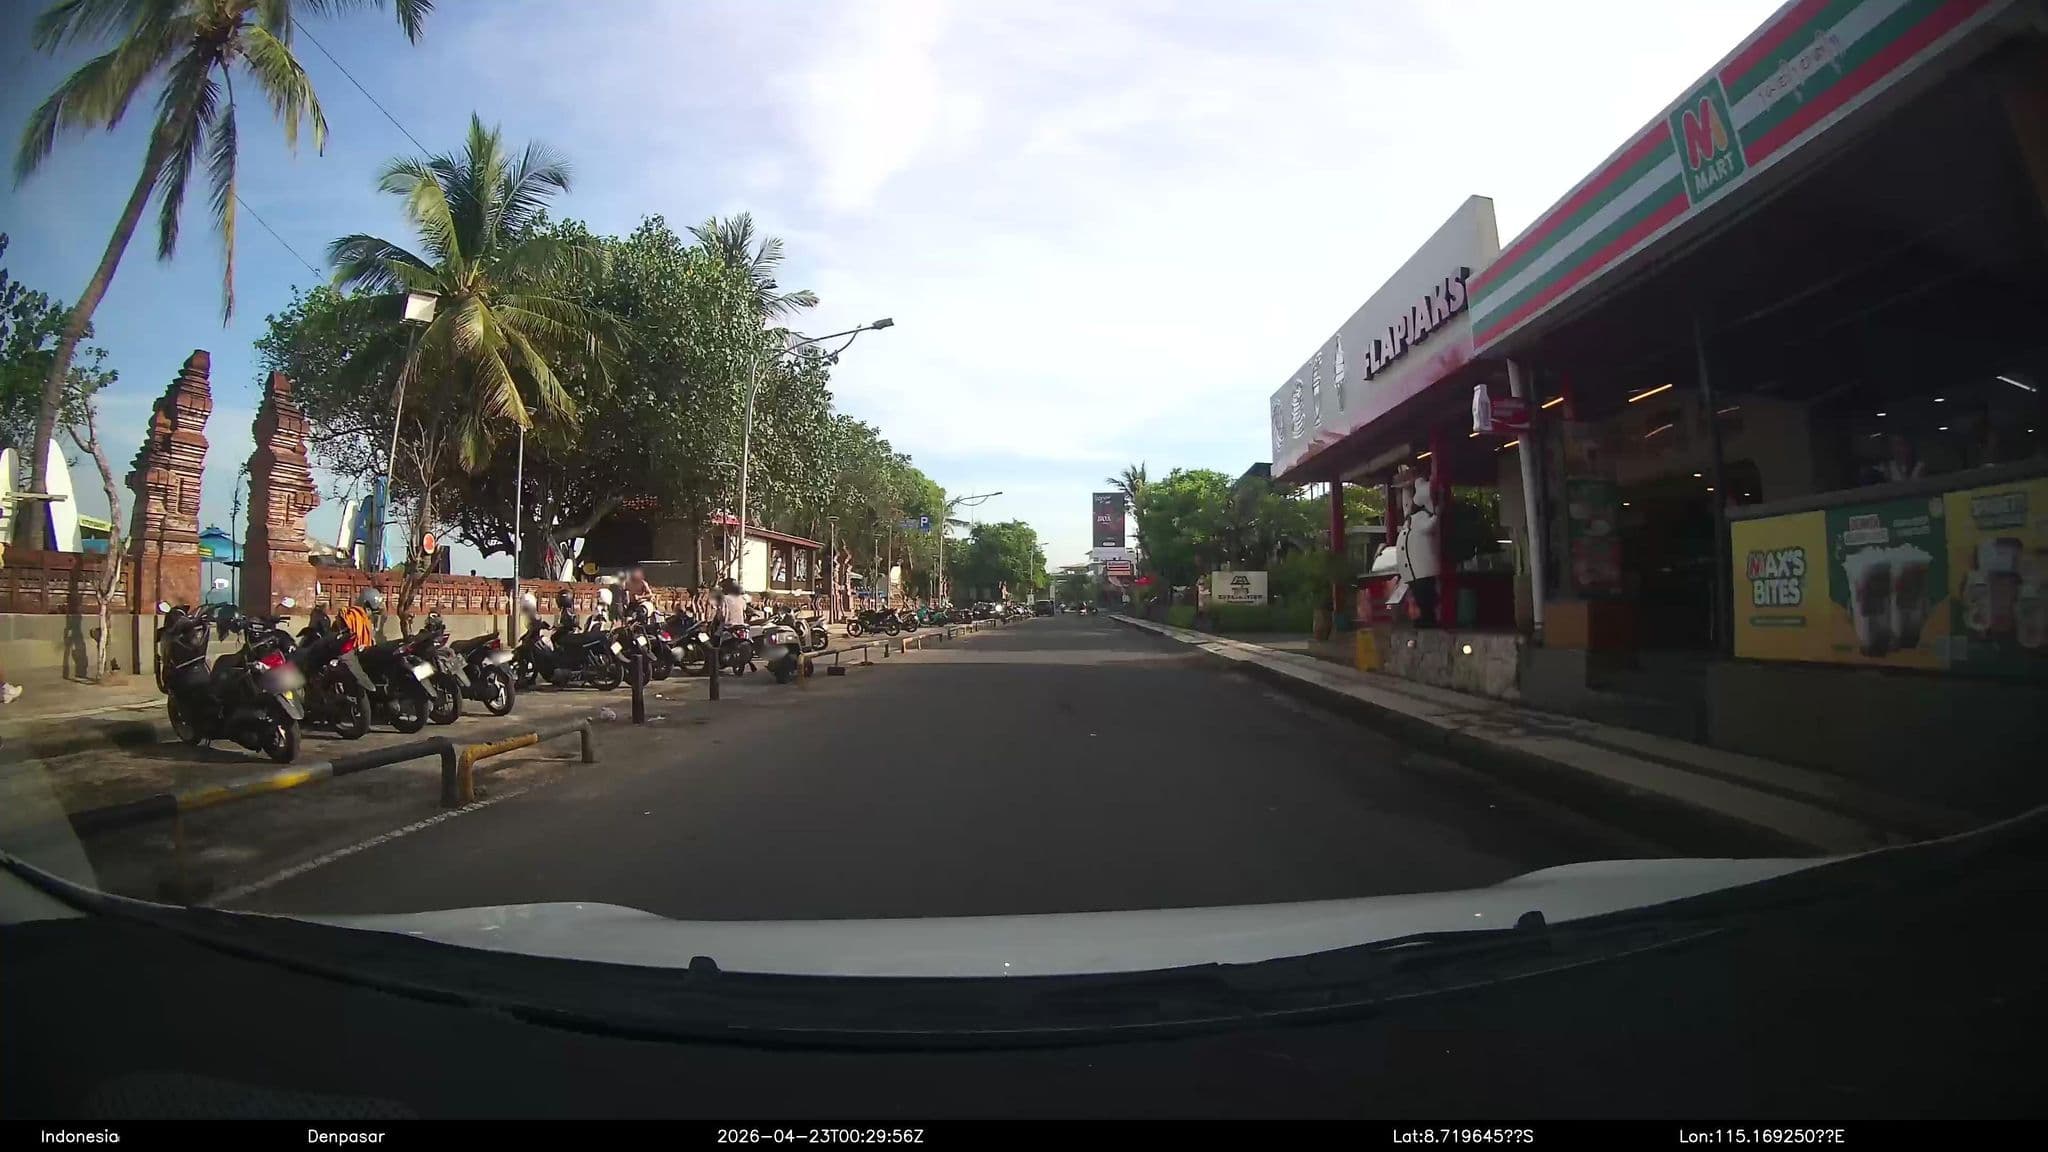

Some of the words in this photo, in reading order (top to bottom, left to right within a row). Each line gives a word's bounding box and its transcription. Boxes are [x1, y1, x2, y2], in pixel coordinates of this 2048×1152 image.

[1694, 153, 1735, 194] MART
[1363, 269, 1468, 380] FLAPJAKS
[920, 516, 929, 527] P
[1747, 547, 1806, 579] MAX'S
[1753, 578, 1802, 606] BITES
